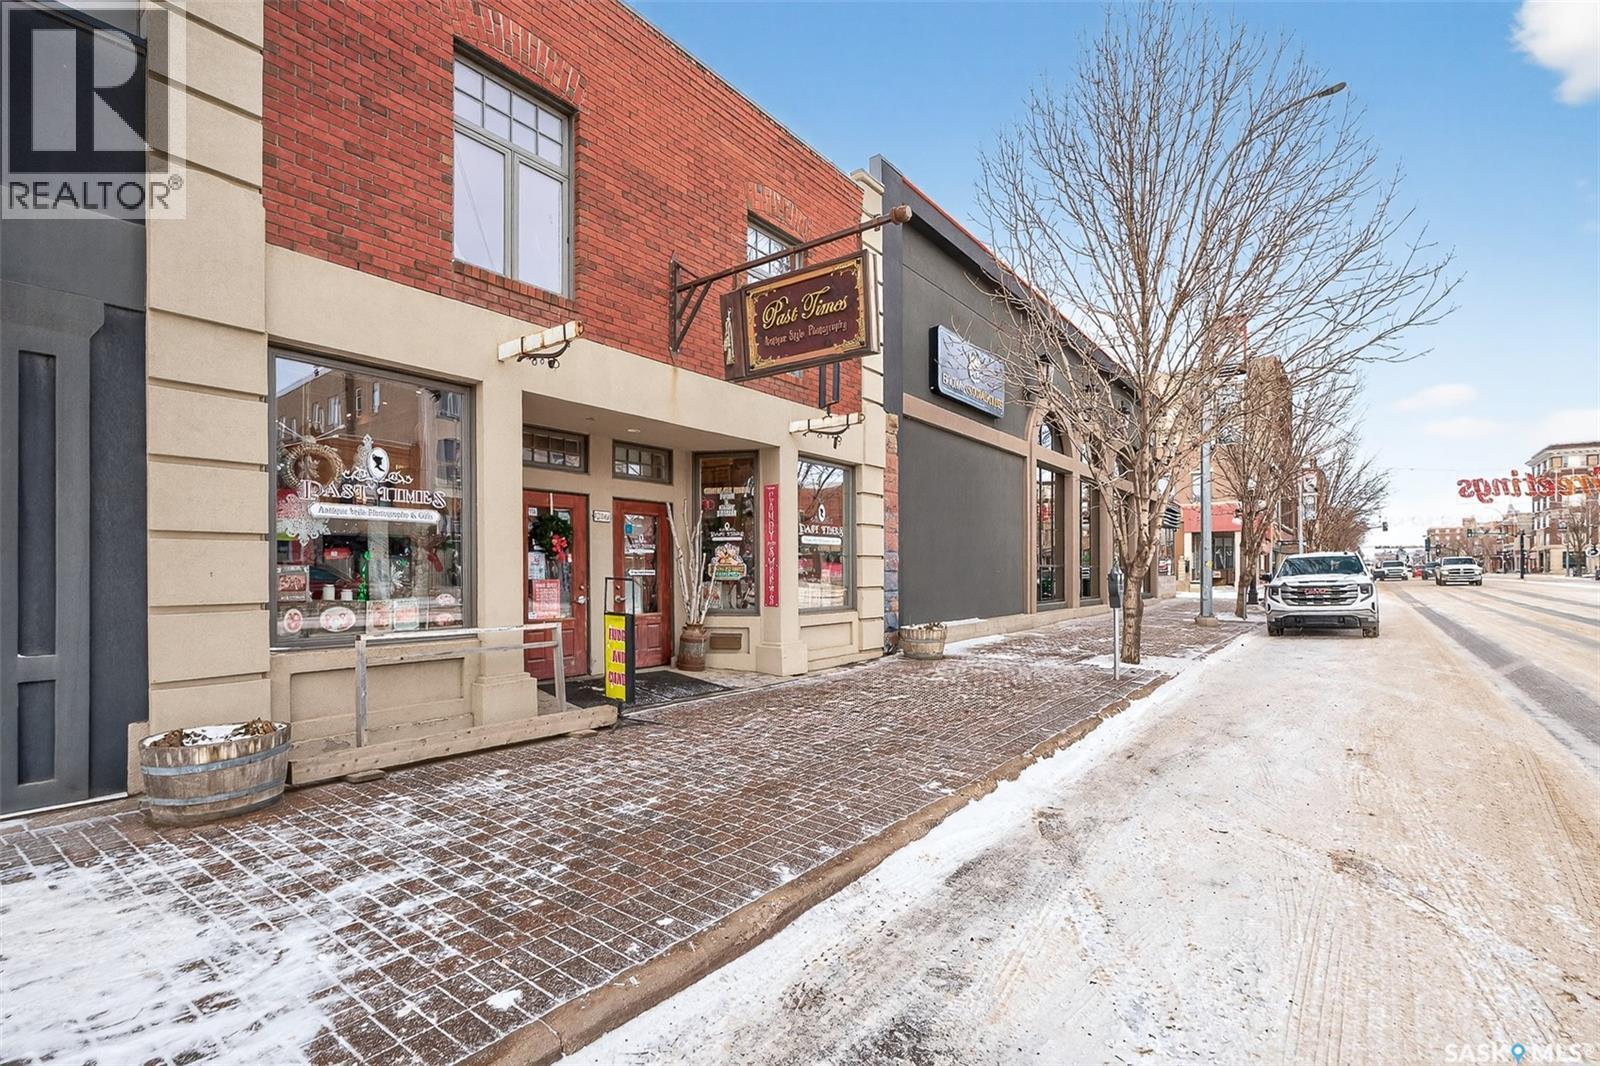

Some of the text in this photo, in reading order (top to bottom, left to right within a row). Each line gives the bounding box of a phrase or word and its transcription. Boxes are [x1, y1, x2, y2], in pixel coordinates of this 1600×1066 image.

[762, 286, 848, 330] Past Times
[300, 479, 447, 508] PAST TIMES
